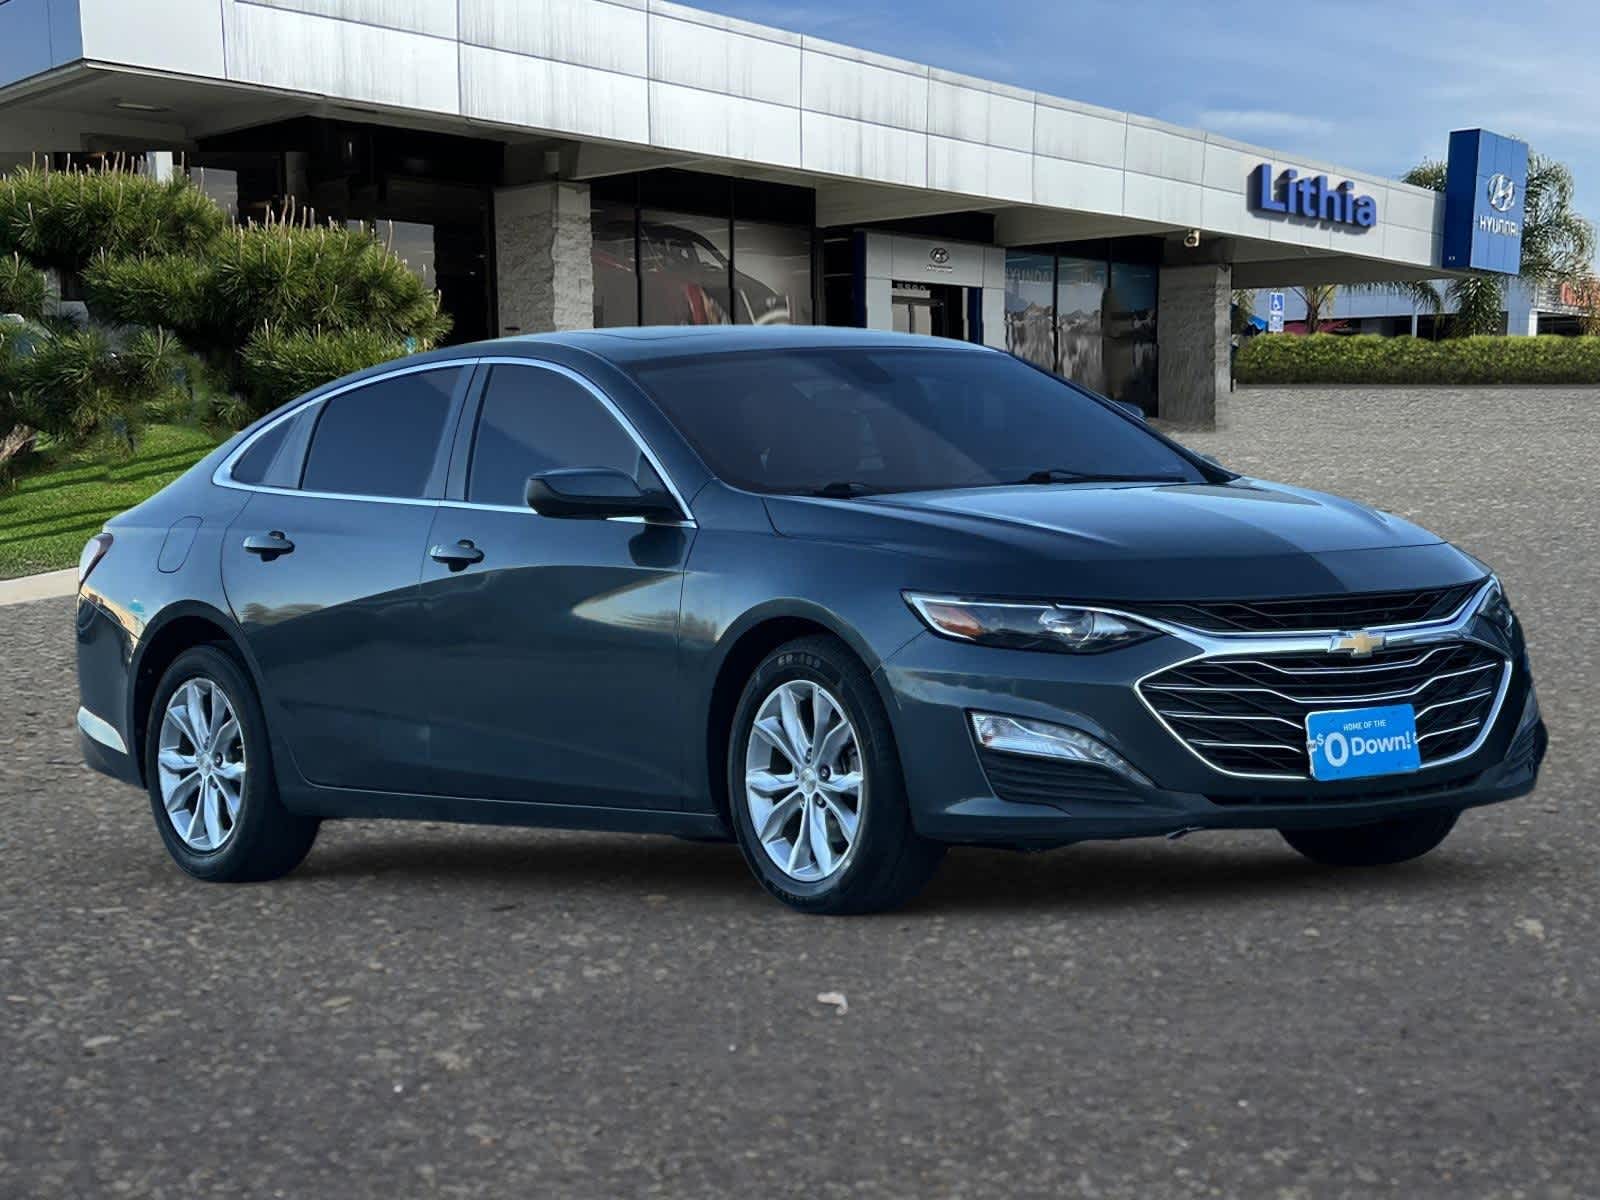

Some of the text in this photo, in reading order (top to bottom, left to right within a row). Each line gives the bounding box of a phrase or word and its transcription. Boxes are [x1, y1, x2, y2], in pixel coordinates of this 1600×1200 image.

[1258, 163, 1376, 227] Lithia
[1480, 215, 1520, 238] HYUNDAI
[1343, 719, 1387, 731] HOME OF THE
[1351, 730, 1412, 756] Down!
